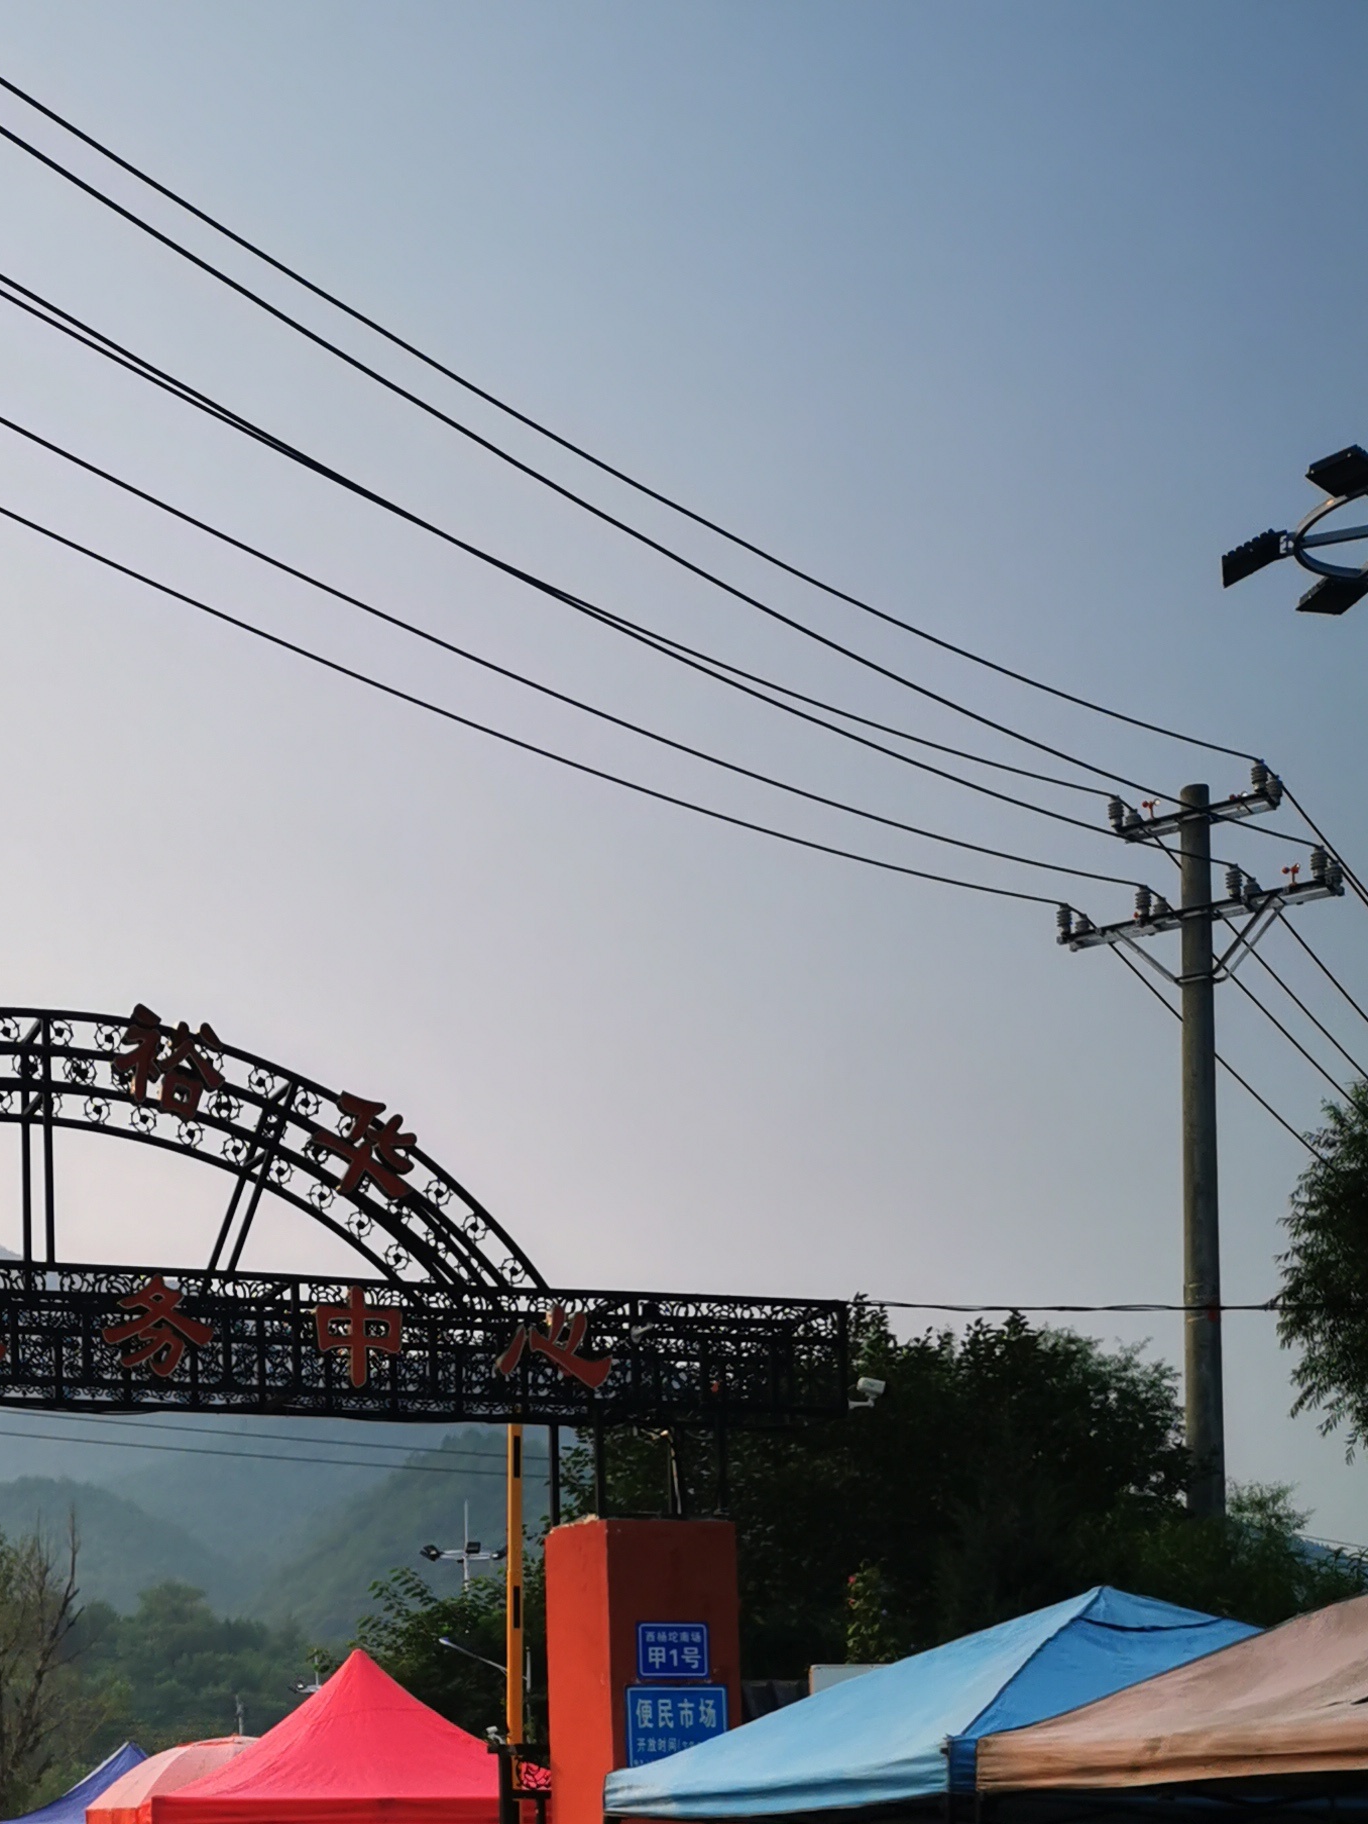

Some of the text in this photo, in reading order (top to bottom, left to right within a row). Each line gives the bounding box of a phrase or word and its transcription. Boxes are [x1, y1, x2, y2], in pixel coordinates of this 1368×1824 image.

[648, 1646, 702, 1670] 甲1号
[635, 1698, 717, 1729] 便民市场
